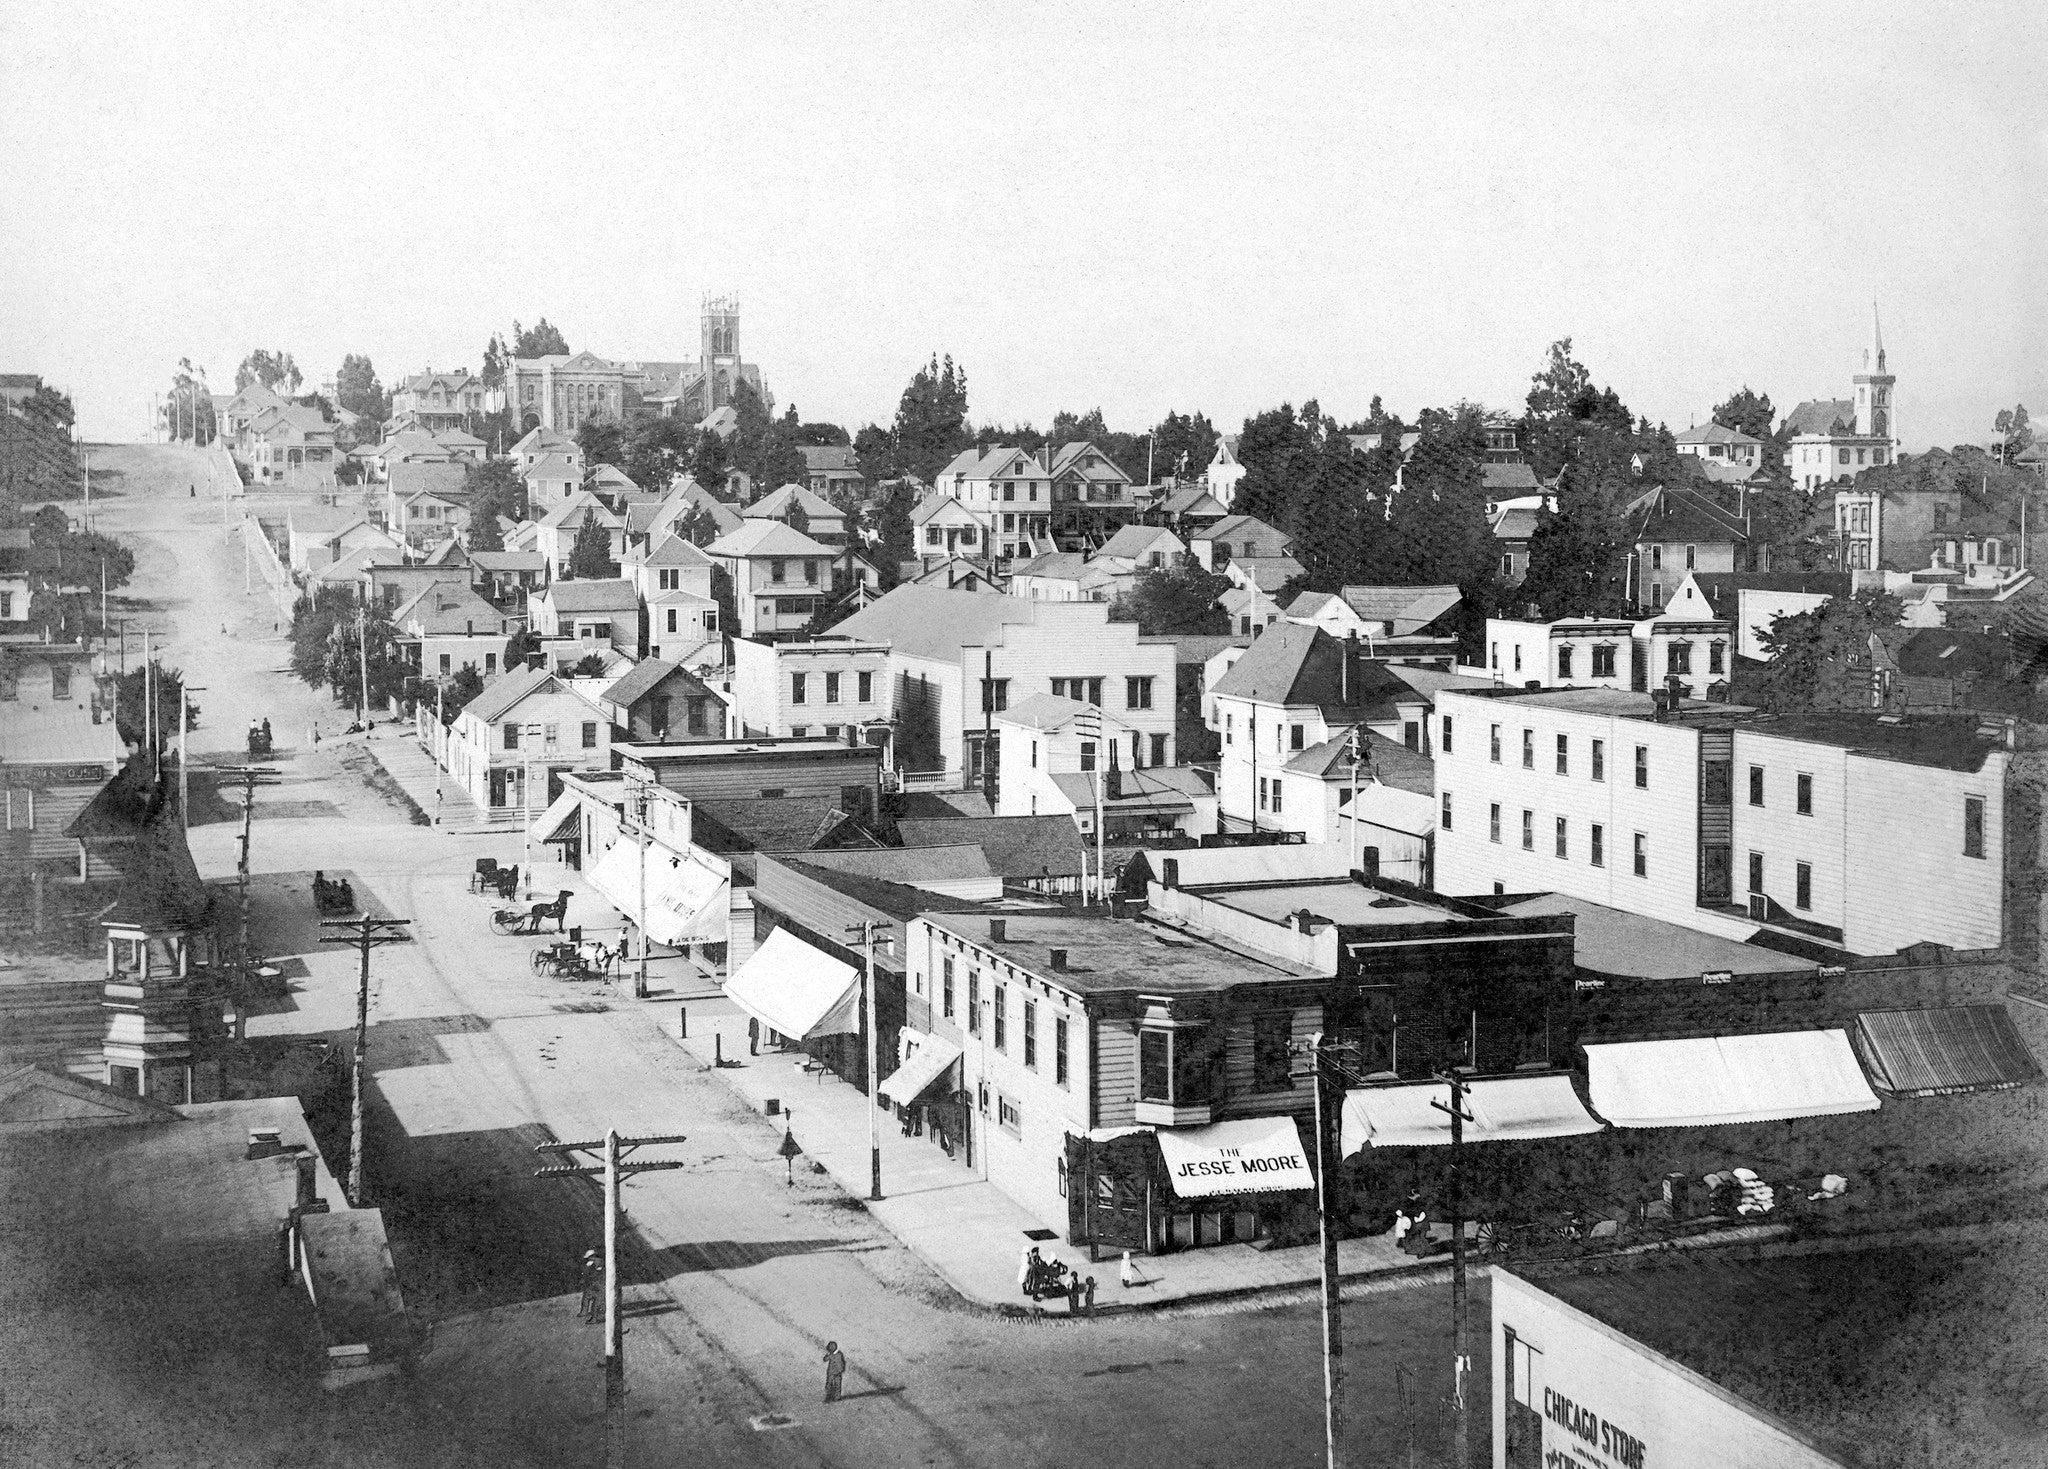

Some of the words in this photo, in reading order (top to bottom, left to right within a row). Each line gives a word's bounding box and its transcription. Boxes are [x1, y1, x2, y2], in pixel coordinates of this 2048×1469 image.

[1219, 1148, 1241, 1158] THE
[1177, 1160, 1236, 1178] JESSE
[1240, 1155, 1304, 1174] MOORE
[1544, 1385, 1598, 1448] CHICAGO
[1601, 1418, 1647, 1469] STORE
